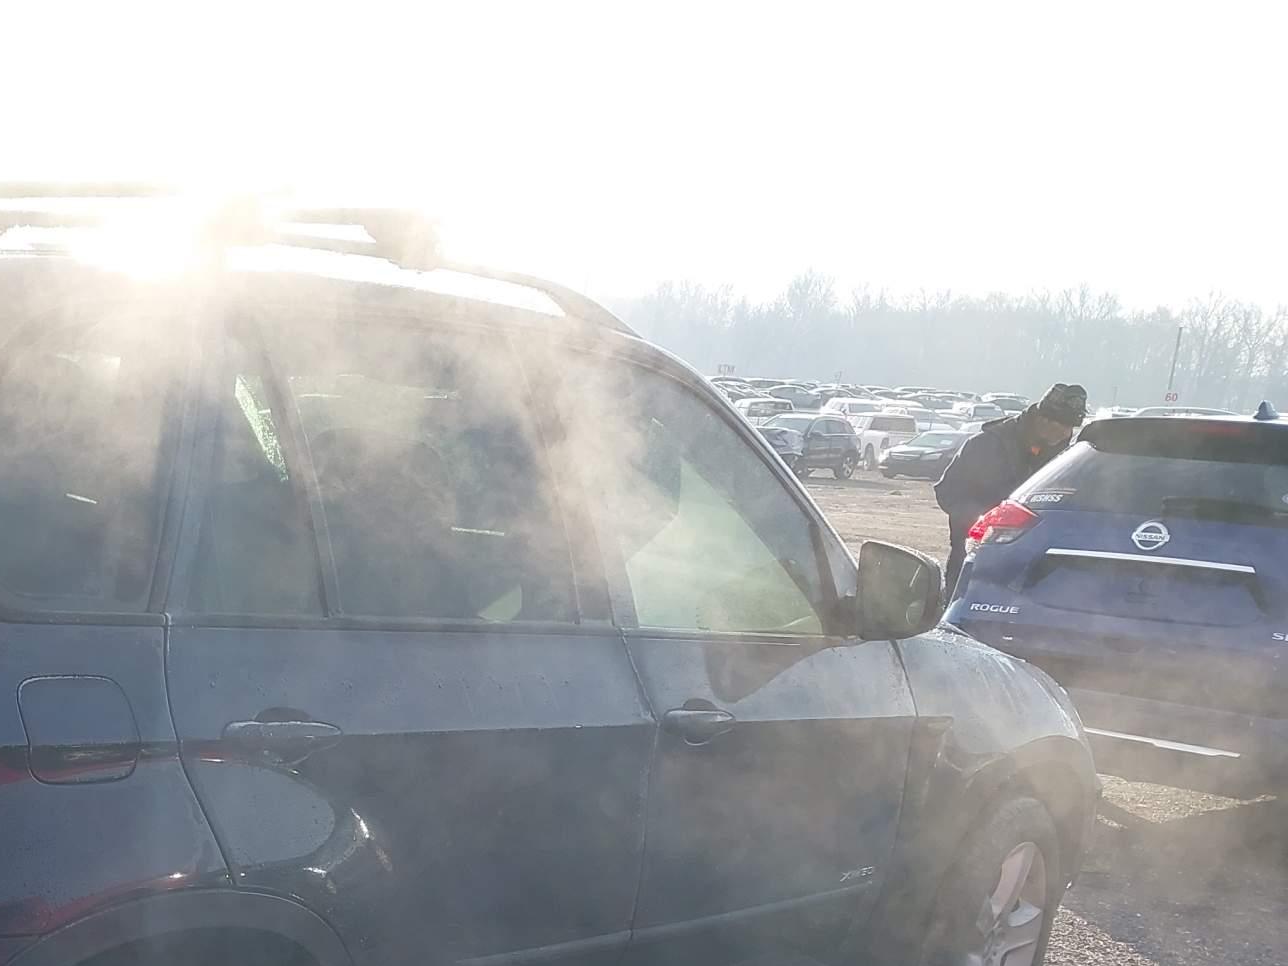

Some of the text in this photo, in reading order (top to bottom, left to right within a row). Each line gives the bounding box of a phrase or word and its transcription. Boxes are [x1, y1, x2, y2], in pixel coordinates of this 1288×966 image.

[1165, 392, 1178, 401] 60
[1135, 533, 1166, 541] NISSAN
[970, 603, 1019, 614] ROGUE
